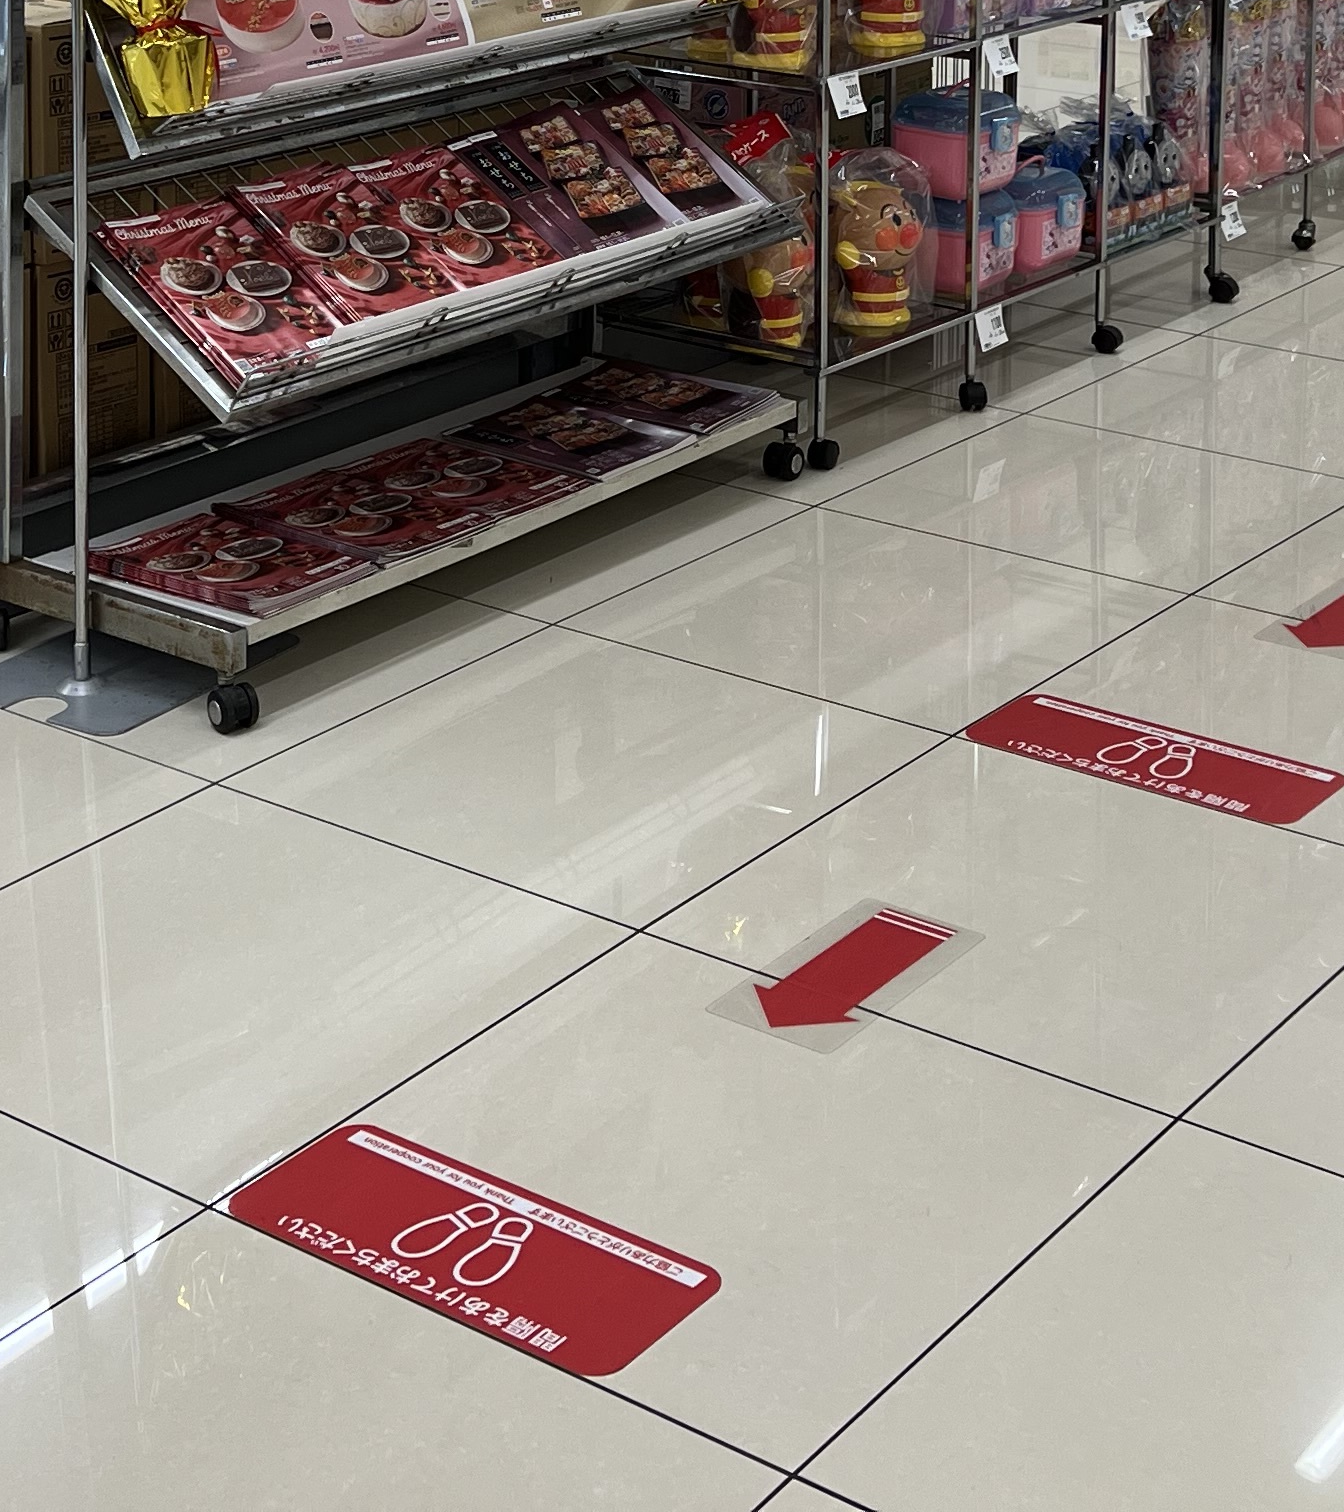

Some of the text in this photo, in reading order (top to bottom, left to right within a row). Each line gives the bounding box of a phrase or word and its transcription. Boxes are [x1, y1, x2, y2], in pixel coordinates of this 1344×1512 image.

[246, 180, 333, 205] Christmas Menu
[356, 157, 436, 184] Christmas Menu
[115, 214, 213, 242] Christmas Menu
[1006, 739, 1250, 813] 間隔をあけておまちください
[362, 1135, 516, 1206] Thank you for your cooperation
[527, 1206, 685, 1277] ご協力ありがとうございます
[276, 1214, 568, 1353] 間隔をあけておまちください
